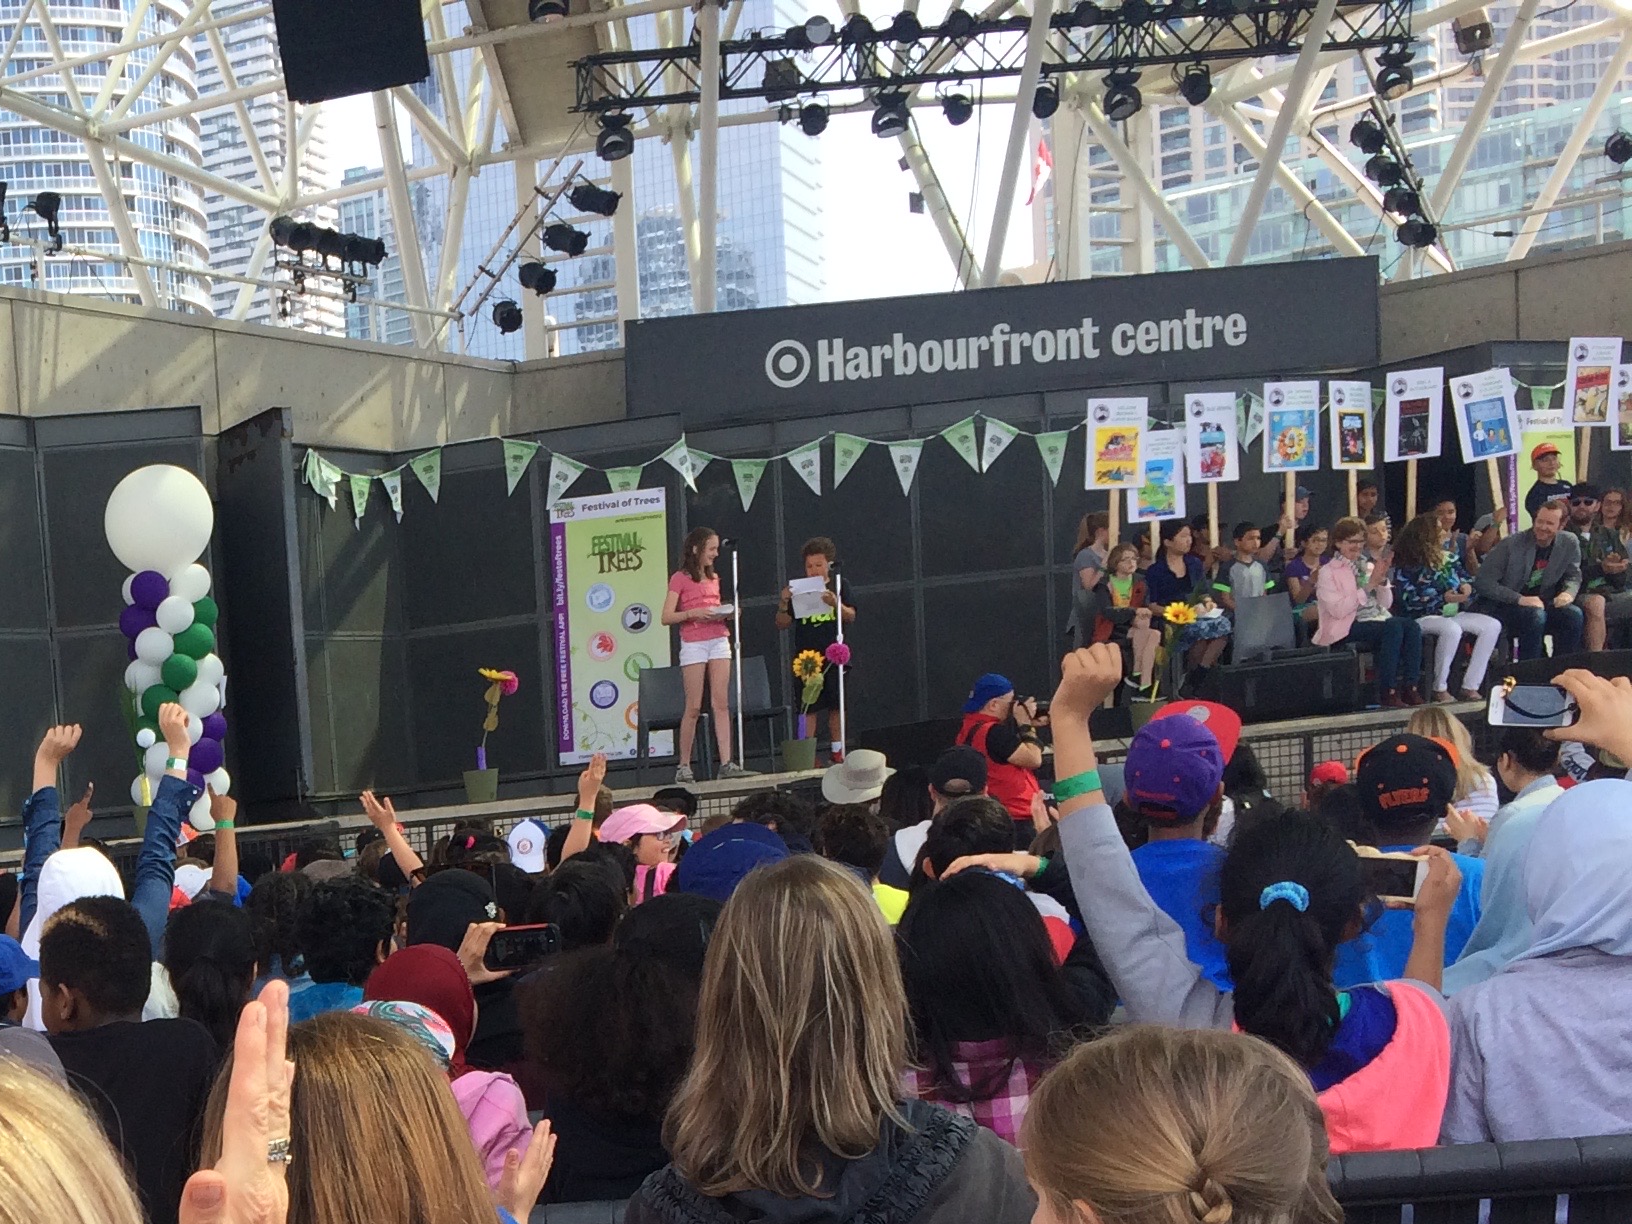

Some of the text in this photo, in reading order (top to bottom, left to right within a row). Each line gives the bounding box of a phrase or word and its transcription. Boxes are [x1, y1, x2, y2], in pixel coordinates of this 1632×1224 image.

[818, 309, 1248, 383] Harbourfront centre
[581, 496, 661, 513] Festival of Trees
[591, 532, 643, 557] FESTIVAL
[597, 548, 644, 575] TREES
[559, 630, 567, 663] FESTIVAL
[560, 682, 568, 697] THE
[562, 698, 570, 741] DOWNLOAD
